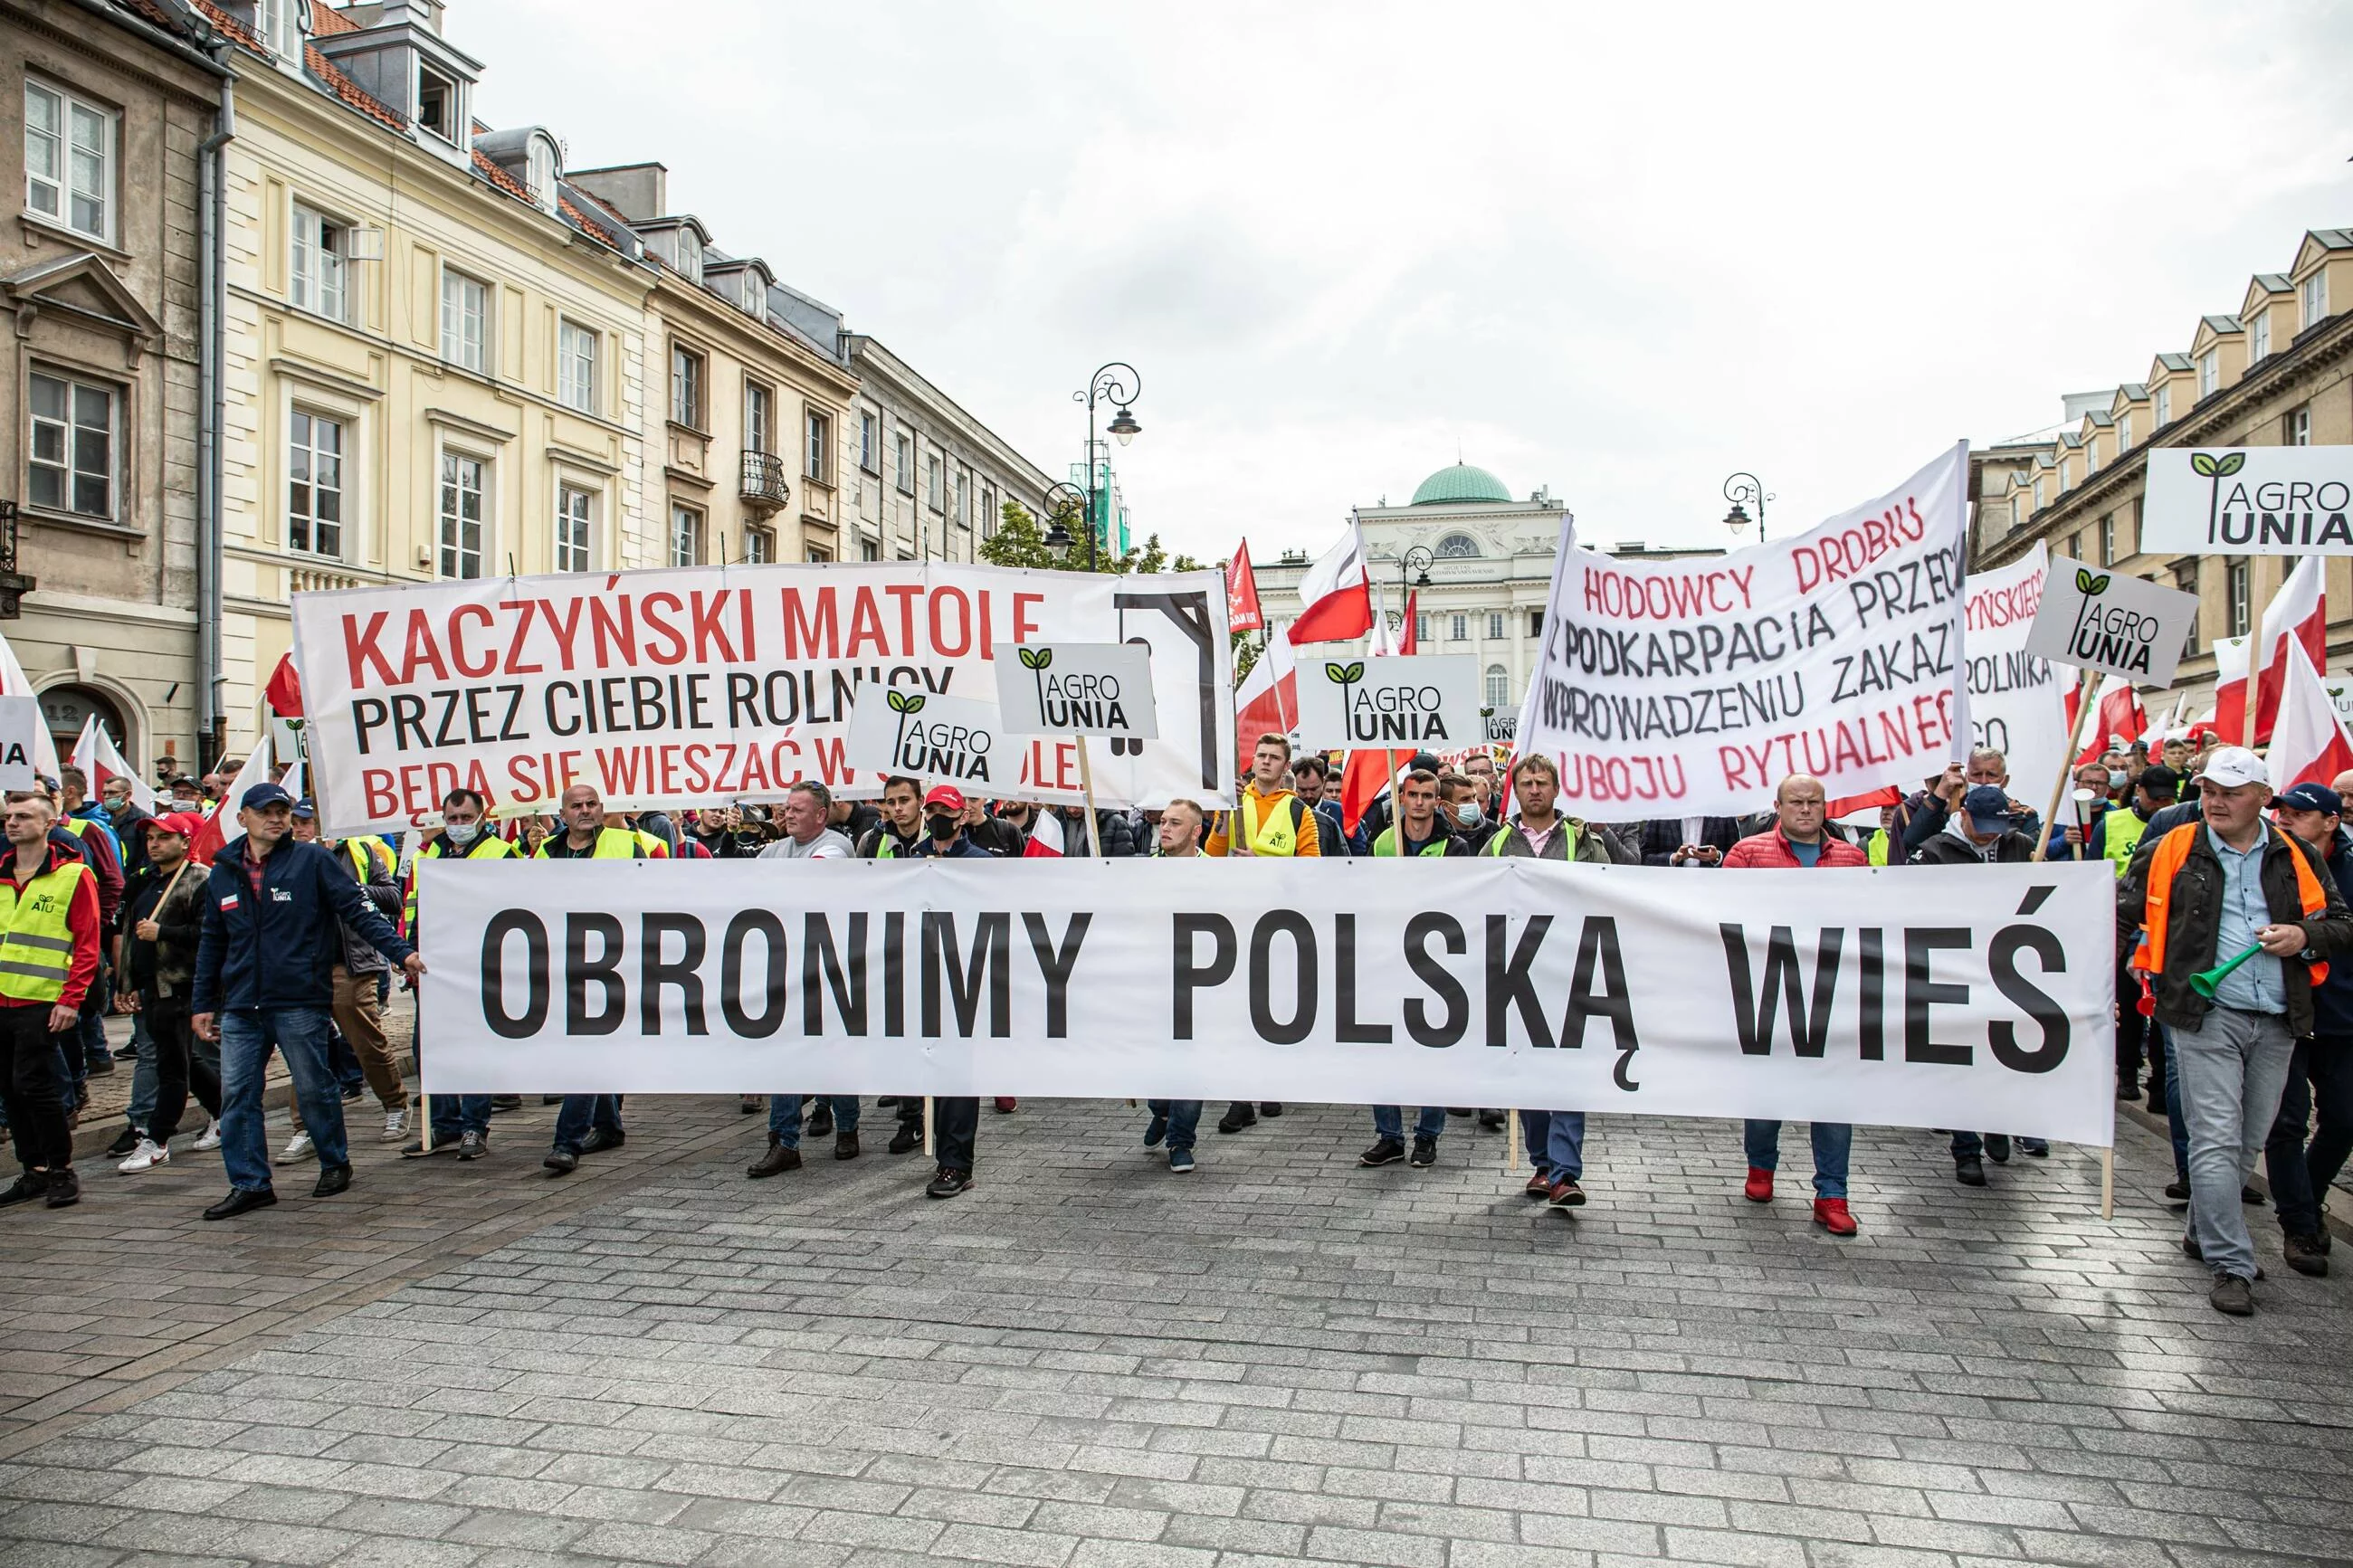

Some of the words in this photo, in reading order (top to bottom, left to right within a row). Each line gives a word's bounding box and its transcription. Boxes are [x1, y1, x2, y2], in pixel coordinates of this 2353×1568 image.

[2223, 481, 2350, 512] AGRO
[2221, 511, 2353, 546] UNIA
[1584, 565, 1755, 621] HODOWCY
[1791, 496, 1925, 594] DROBIU
[1565, 603, 1837, 679] PODKARPACIA
[1849, 543, 1964, 630] PRZEC
[2082, 603, 2159, 643] AGRO
[342, 574, 757, 690] KACZYŃSKI
[2075, 628, 2150, 675] UNIA
[1046, 673, 1120, 701] AGRO
[1354, 686, 1441, 713] AGRO
[1542, 670, 1805, 742] WPROWADZENIU
[1831, 620, 1956, 705] ZAKAZ
[46, 704, 80, 722] 12
[352, 684, 530, 755] PRZEZ
[544, 672, 713, 736] CIEBIE
[727, 665, 955, 729] ROLNY
[1046, 698, 1130, 730] UNIA
[1354, 712, 1450, 741] UNIA
[905, 719, 992, 755] AGRO
[1490, 727, 1517, 740] UN
[0, 742, 28, 766] A
[903, 743, 990, 783] UNIA
[361, 759, 500, 828] BĘDĄ
[595, 727, 803, 796] WIESZAĆ
[1558, 751, 1688, 802] UBOJU
[480, 908, 1094, 1040] OBRONIMY
[1172, 908, 1641, 1092] POLSKĄ
[1719, 885, 2072, 1074] WIEŚ
